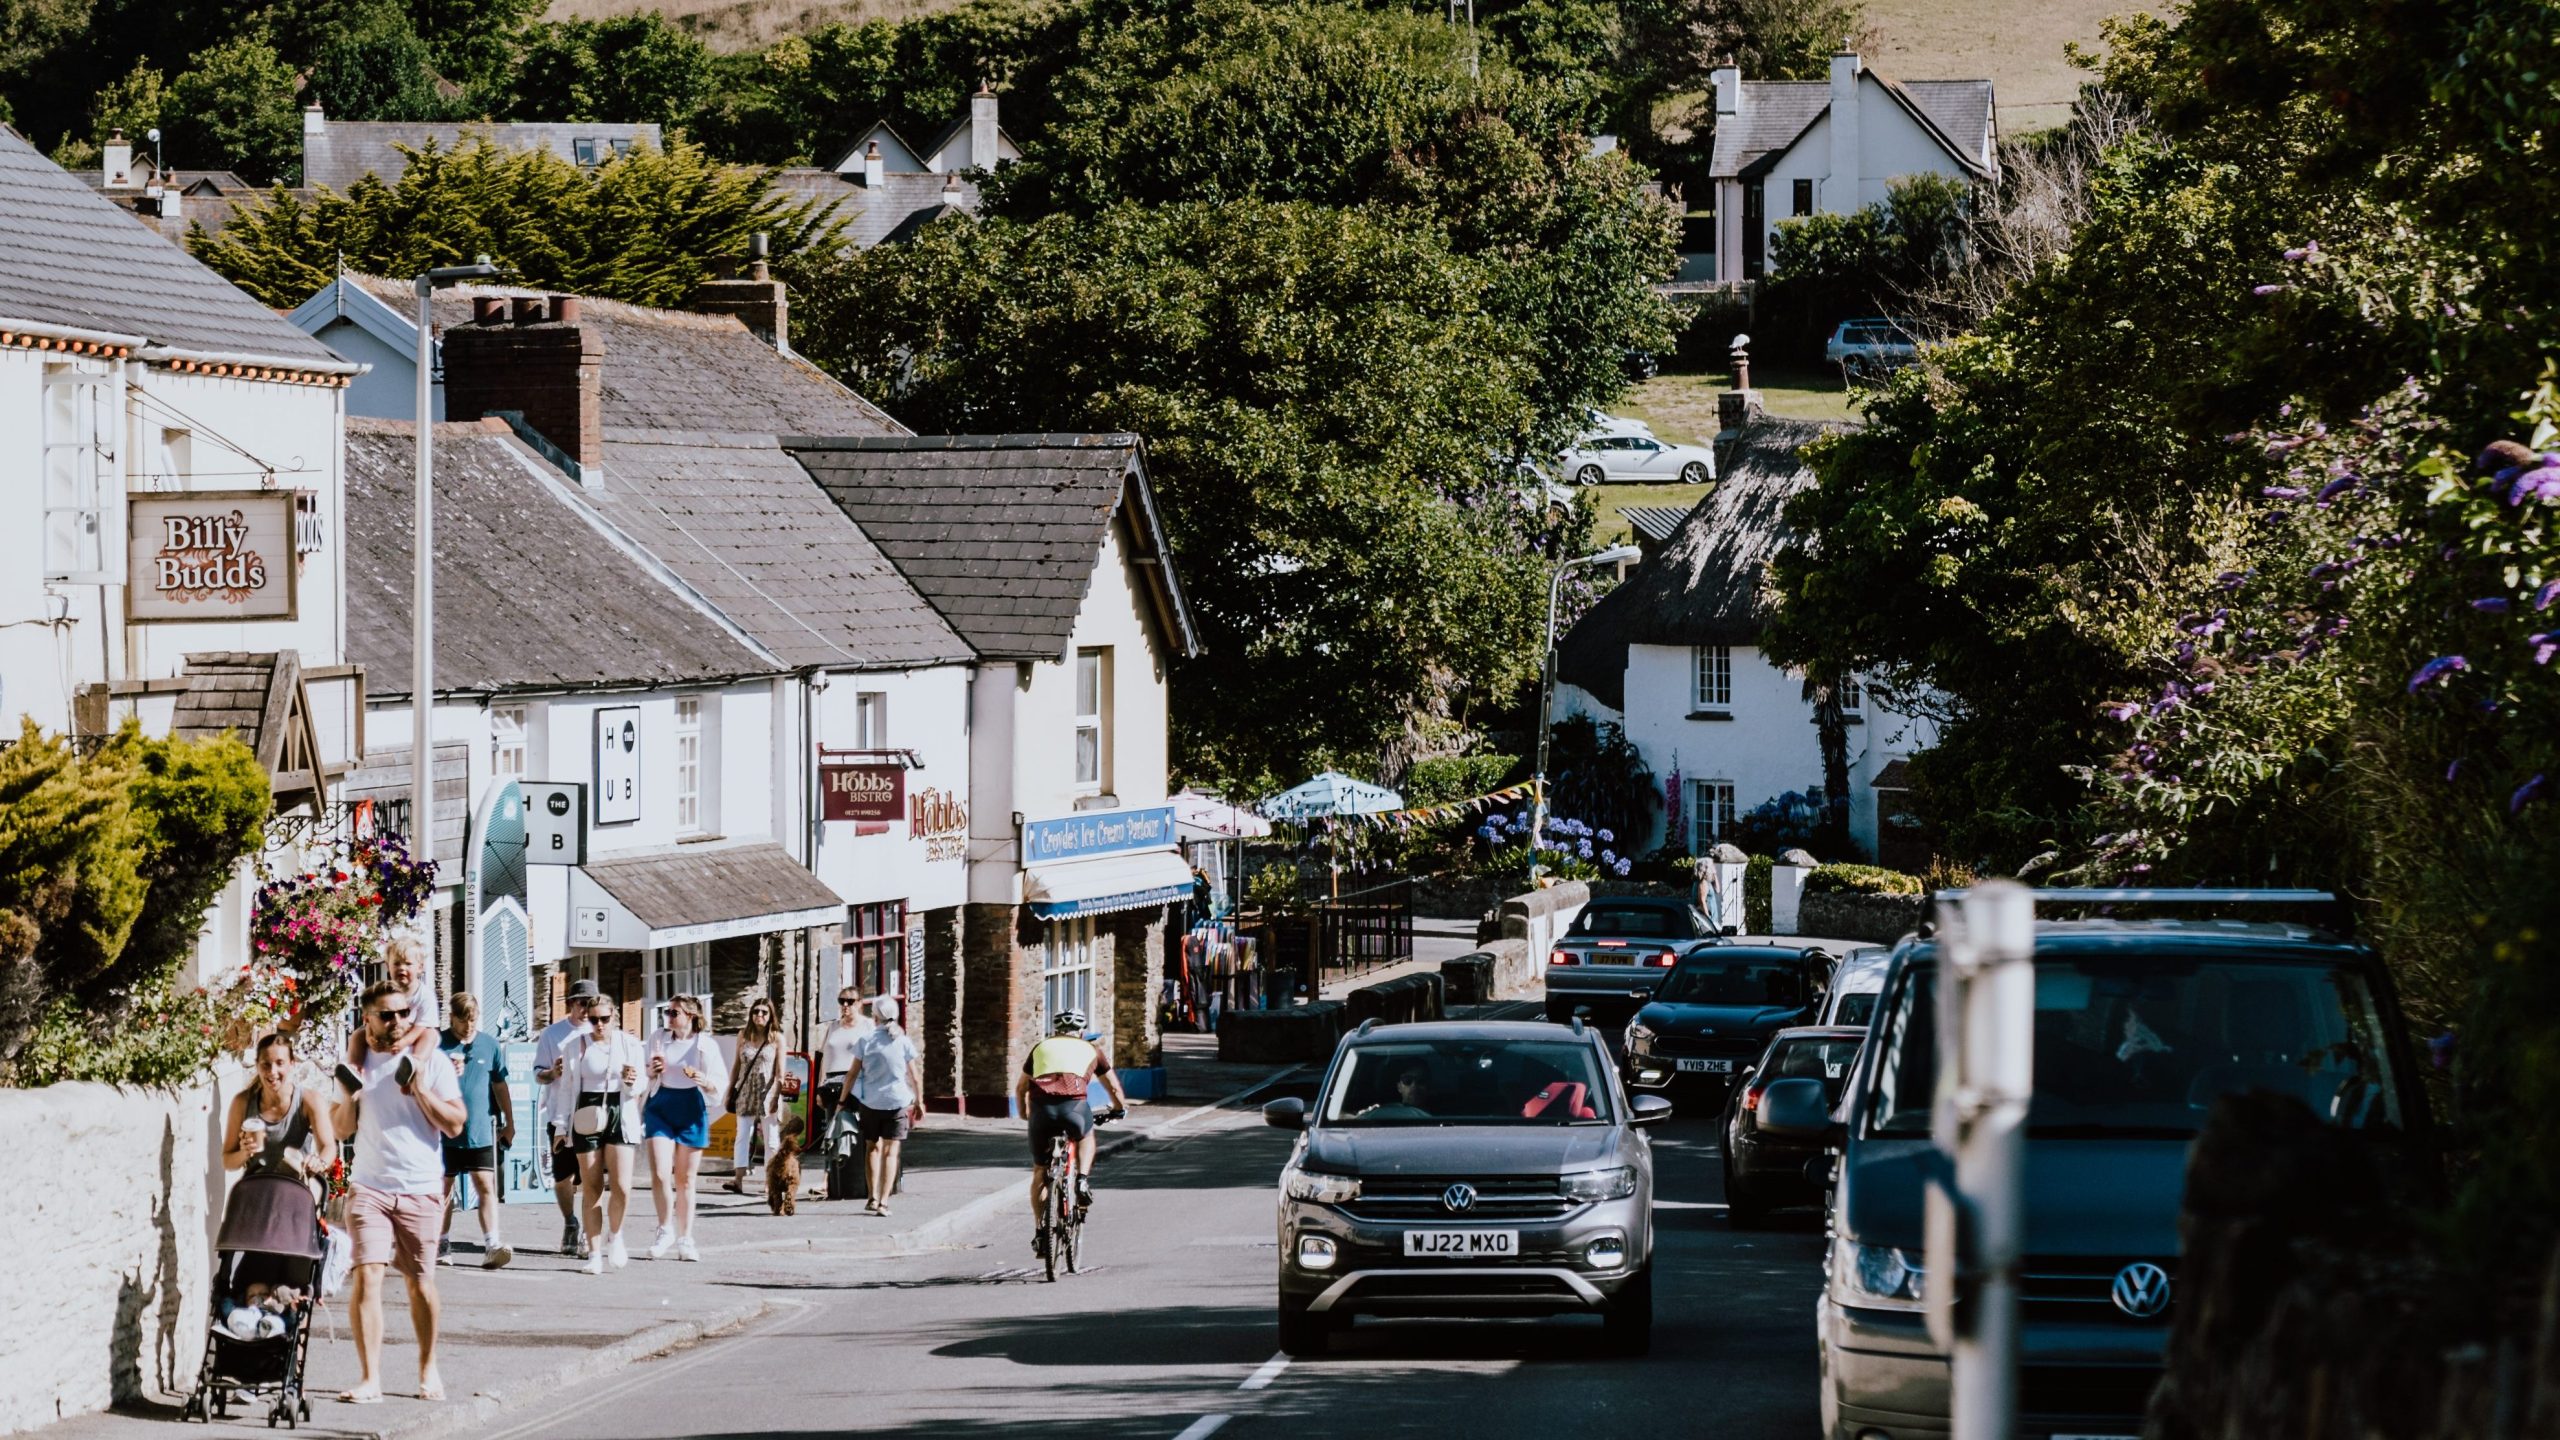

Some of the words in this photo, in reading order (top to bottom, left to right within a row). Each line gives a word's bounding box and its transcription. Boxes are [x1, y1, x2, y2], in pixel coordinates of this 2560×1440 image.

[164, 515, 248, 560] Billy
[155, 553, 266, 591] Budds
[831, 771, 894, 792] Hobbs
[849, 792, 892, 803] BISTRO
[552, 834, 564, 850] B
[1041, 822, 1078, 856] Croyde's
[1081, 822, 1095, 848] Ice
[1097, 820, 1124, 846] Cream
[1127, 813, 1159, 845] Parlour
[466, 884, 475, 935] SALTROCK
[1683, 1060, 1705, 1071] YV19
[1706, 1060, 1726, 1071] ZHE
[1412, 1234, 1464, 1252] WJ22
[1470, 1234, 1508, 1252] MXO
